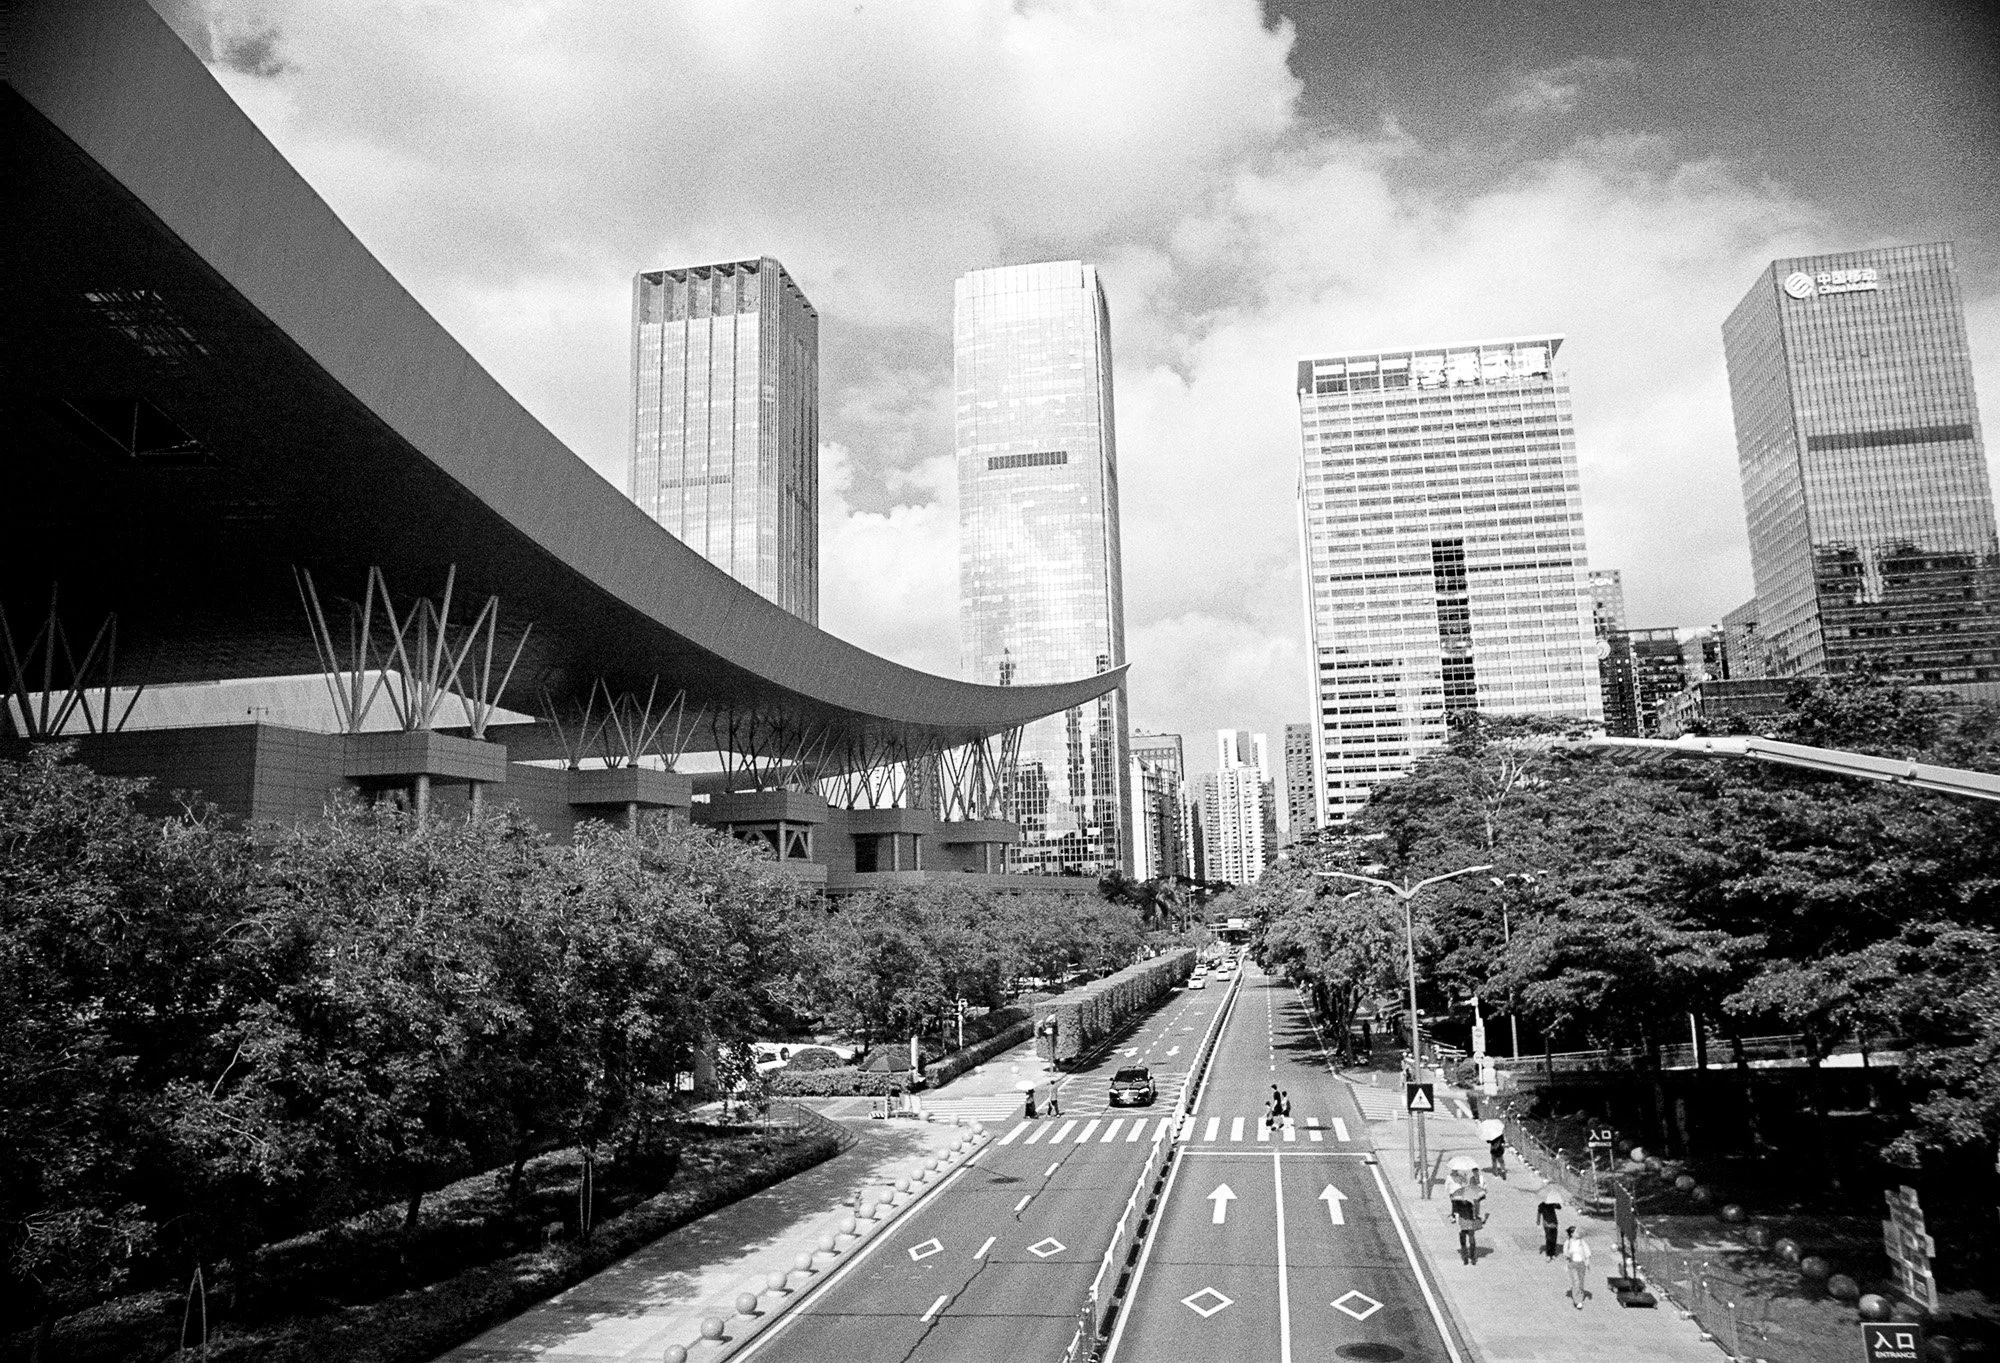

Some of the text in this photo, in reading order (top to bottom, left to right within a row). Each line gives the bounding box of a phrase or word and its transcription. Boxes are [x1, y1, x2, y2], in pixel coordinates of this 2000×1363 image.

[1588, 1129, 1612, 1141] 入口
[1873, 1330, 1915, 1350] 入口
[1874, 1350, 1918, 1359] ENTRANCE
